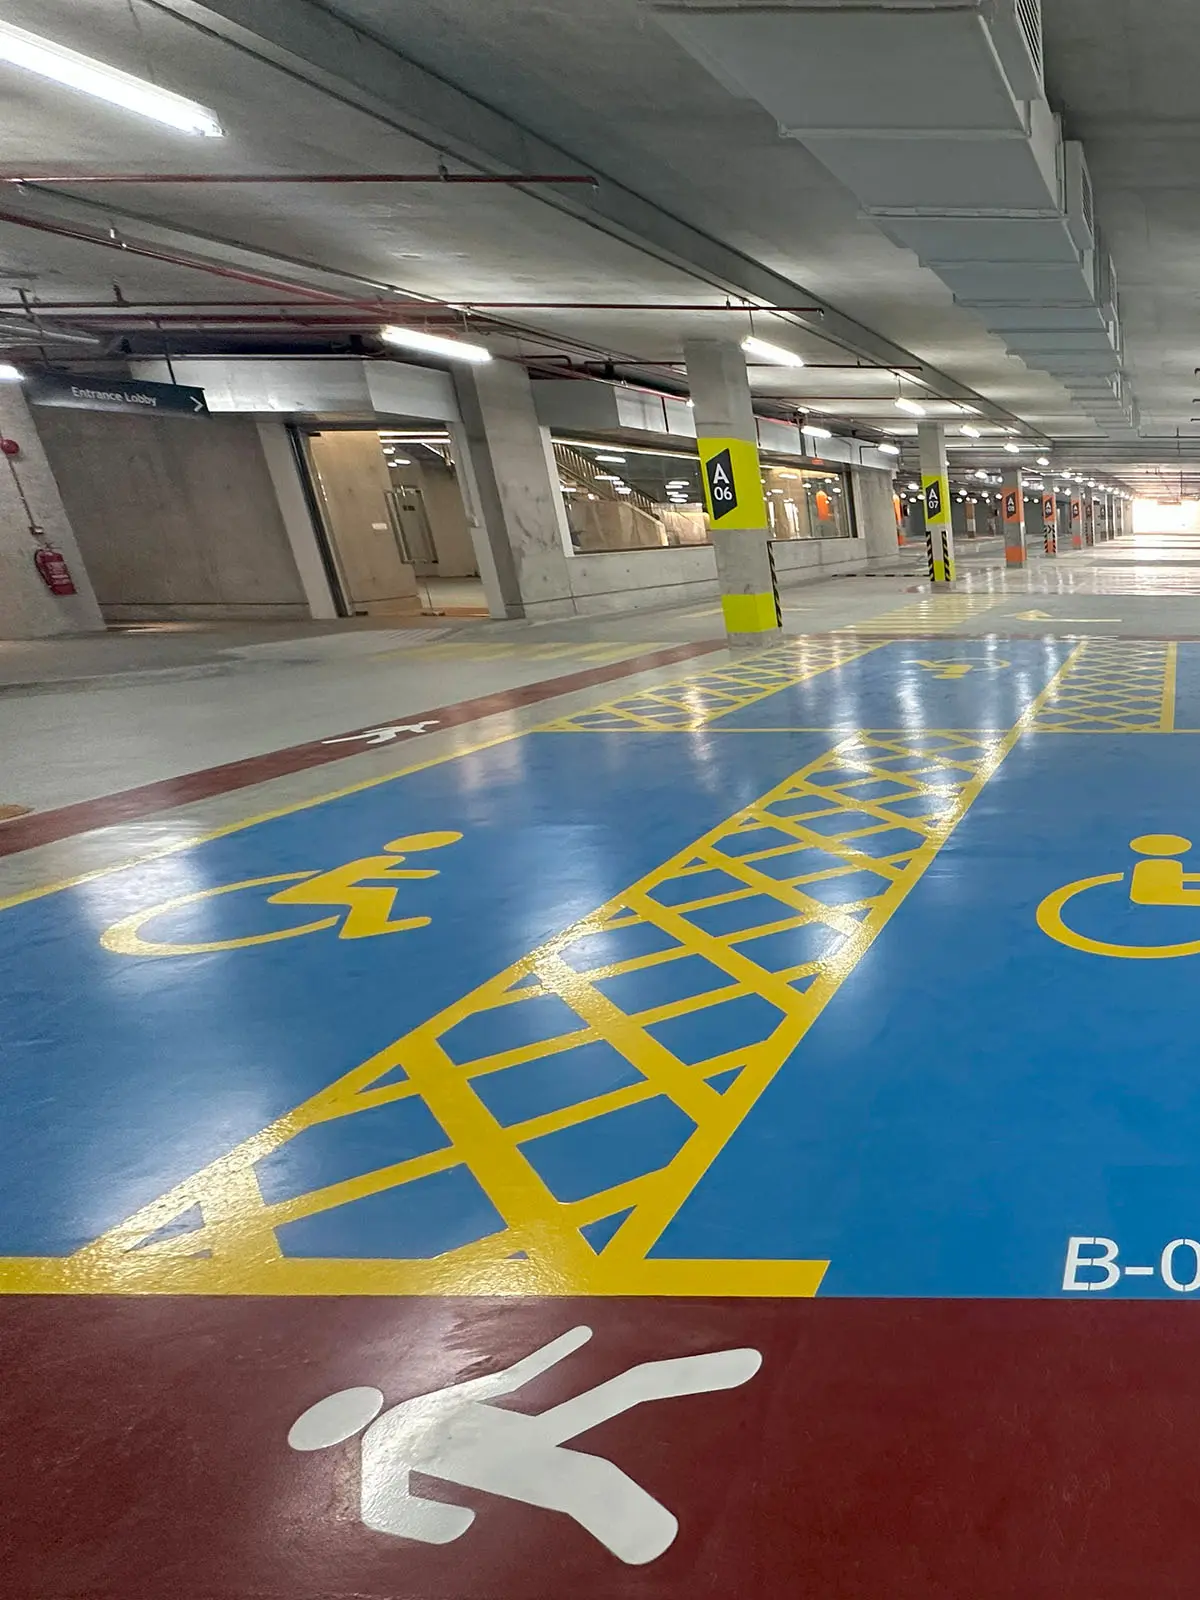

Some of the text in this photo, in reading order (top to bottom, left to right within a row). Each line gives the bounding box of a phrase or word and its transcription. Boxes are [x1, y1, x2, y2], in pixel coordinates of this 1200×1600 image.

[71, 386, 156, 407] Entrance Lobby
[713, 463, 730, 484] A
[714, 486, 733, 501] 06
[929, 488, 938, 500] A
[928, 500, 939, 509] 07
[1007, 496, 1014, 505] A
